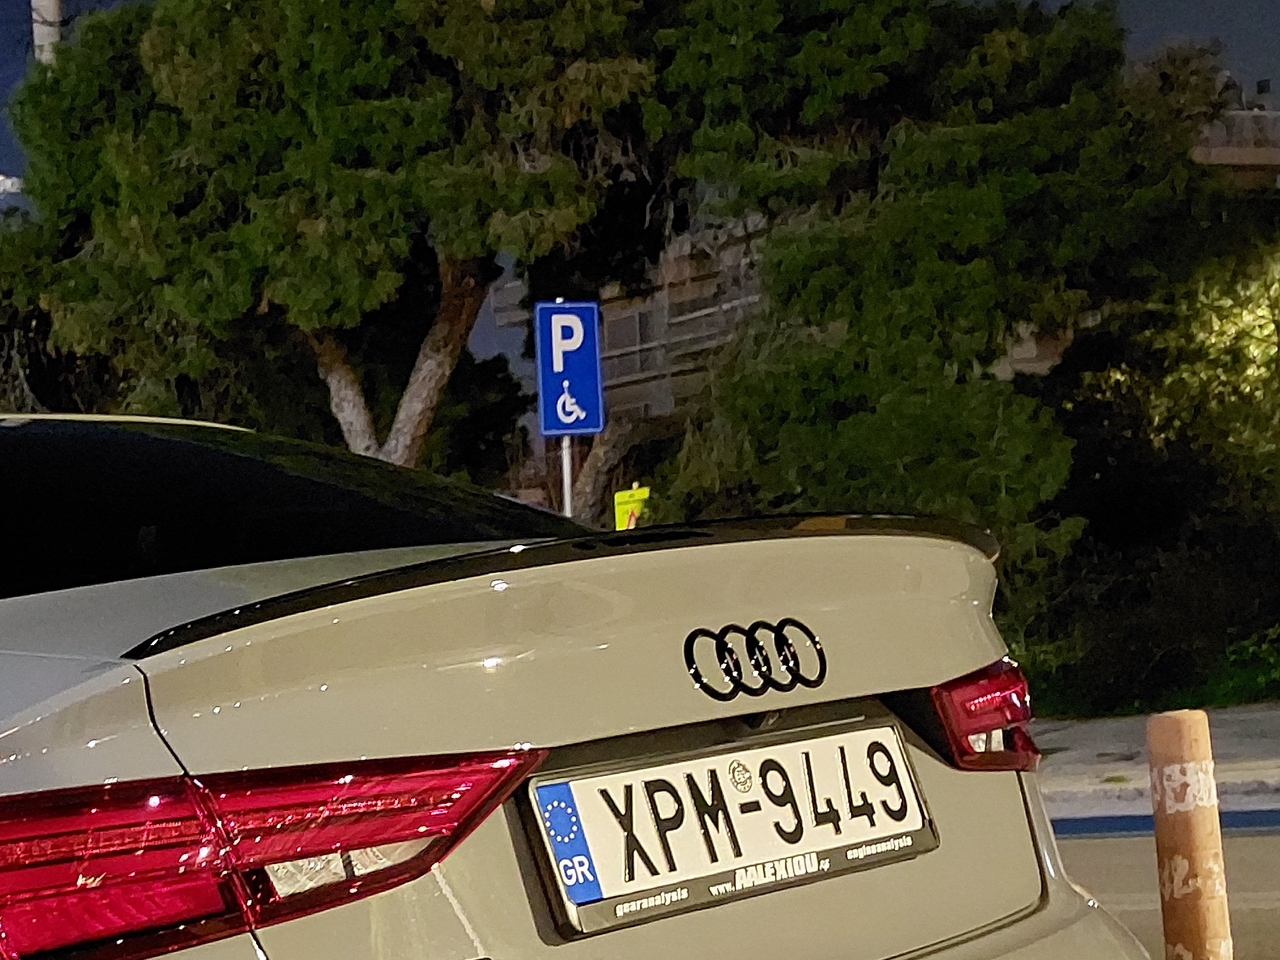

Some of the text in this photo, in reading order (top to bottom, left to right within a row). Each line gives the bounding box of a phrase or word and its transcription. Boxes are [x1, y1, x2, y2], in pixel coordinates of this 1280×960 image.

[551, 314, 584, 372] P
[598, 741, 908, 881] XPM-9449
[559, 855, 594, 886] GR
